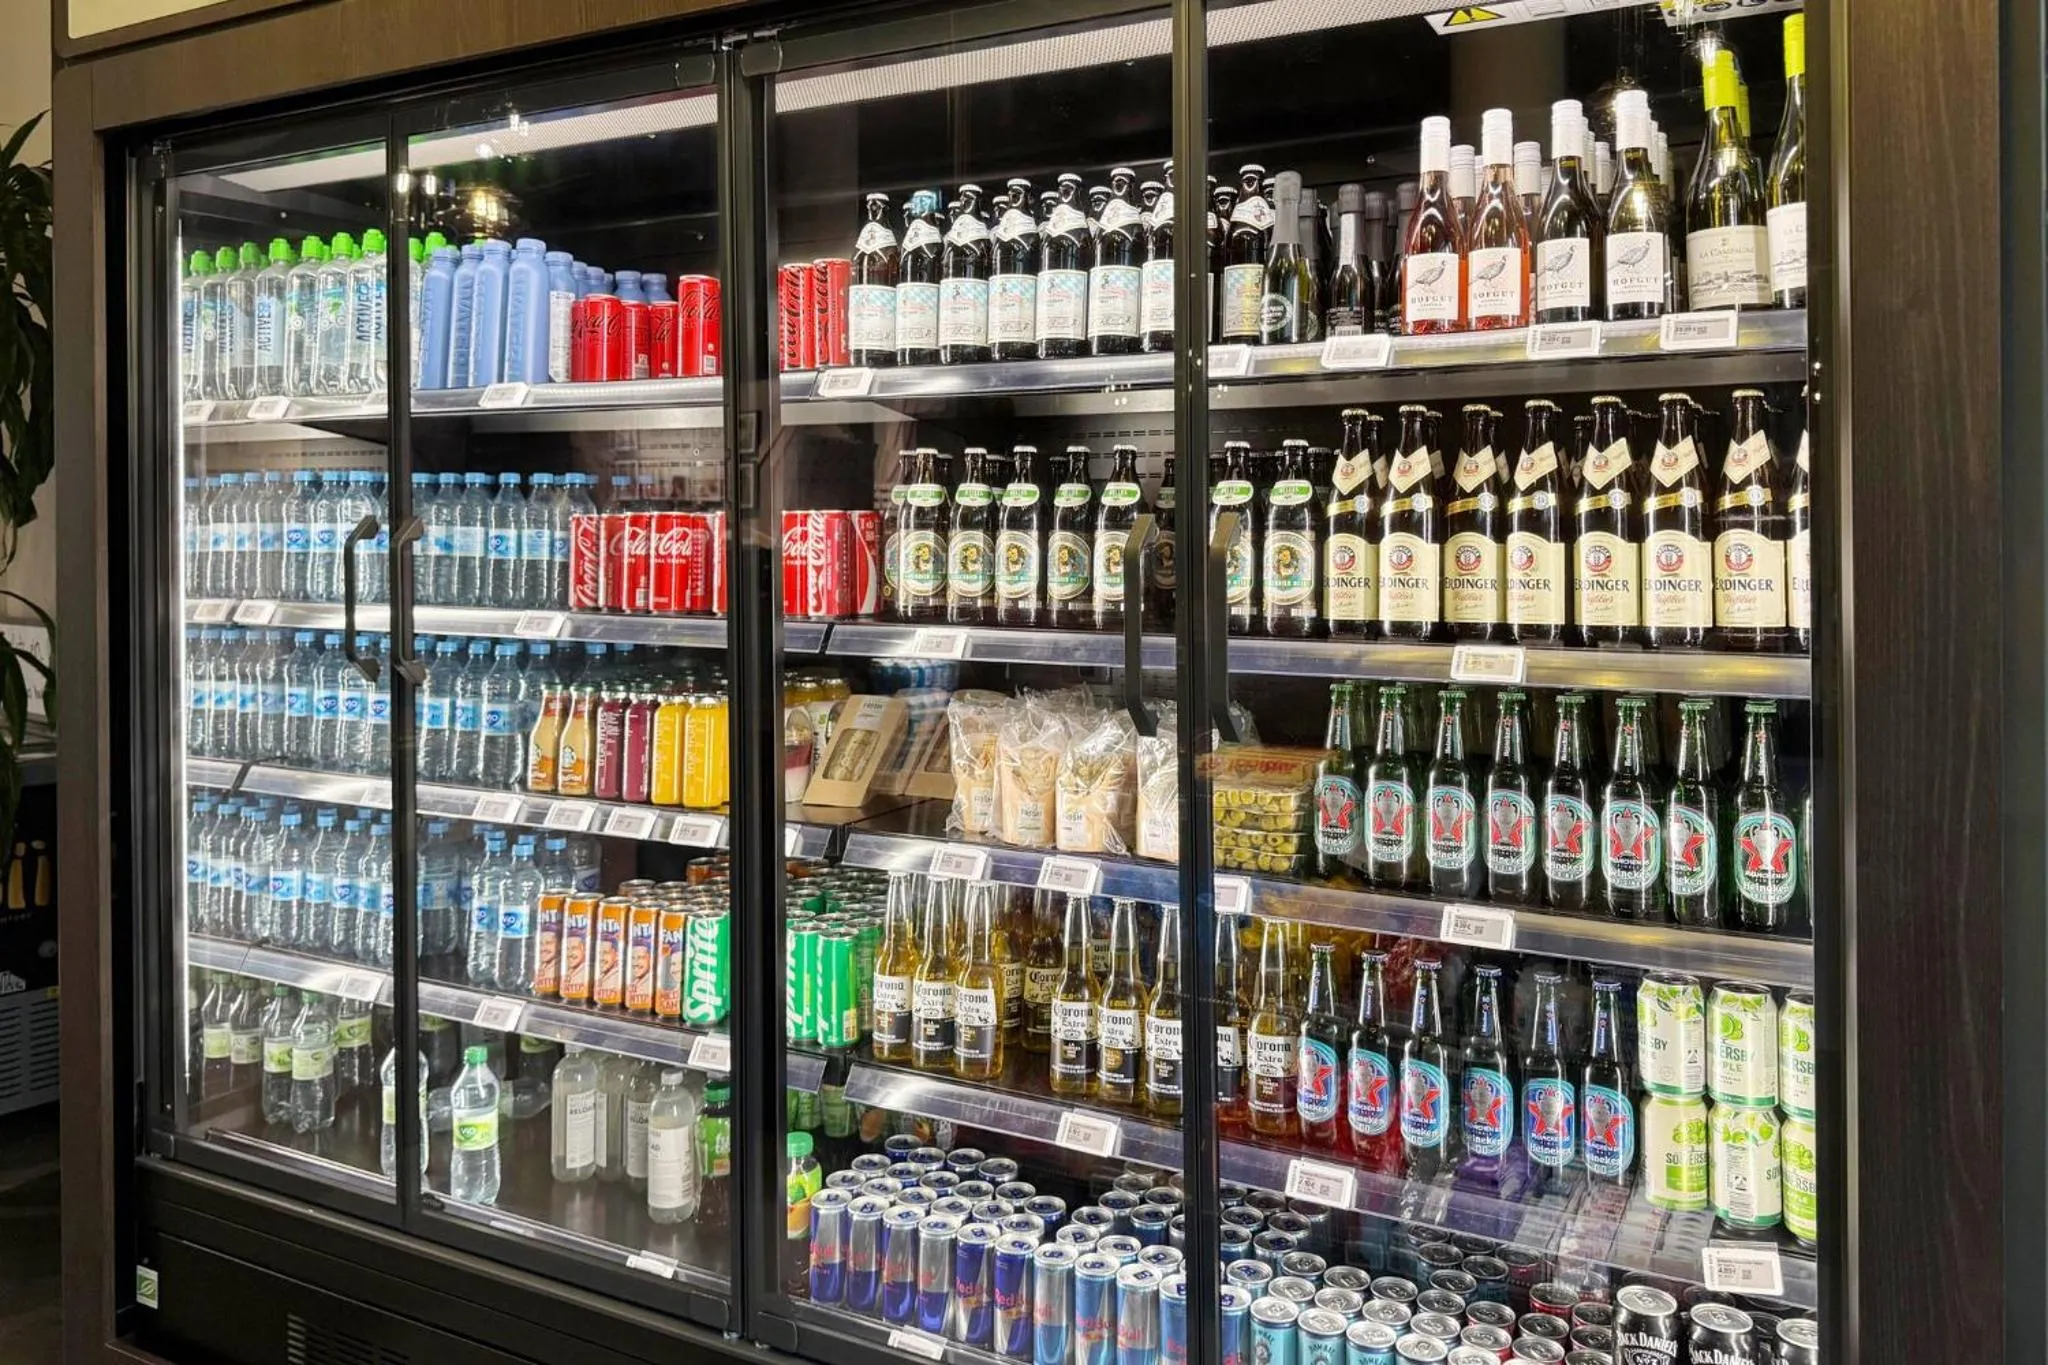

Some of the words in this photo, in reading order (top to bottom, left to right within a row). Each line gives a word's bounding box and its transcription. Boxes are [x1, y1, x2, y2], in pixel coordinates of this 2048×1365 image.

[1444, 578, 1497, 591] ERDINGER
[1644, 577, 1702, 593] ERDINGER
[1715, 577, 1774, 592] ERDINGER
[686, 916, 723, 1022] Sprite
[1053, 1001, 1093, 1018] Corona
[1061, 1017, 1087, 1028] Extra
[1154, 1035, 1180, 1047] Extra
[1249, 1035, 1292, 1053] Corona
[1617, 1330, 1638, 1347] JACK
